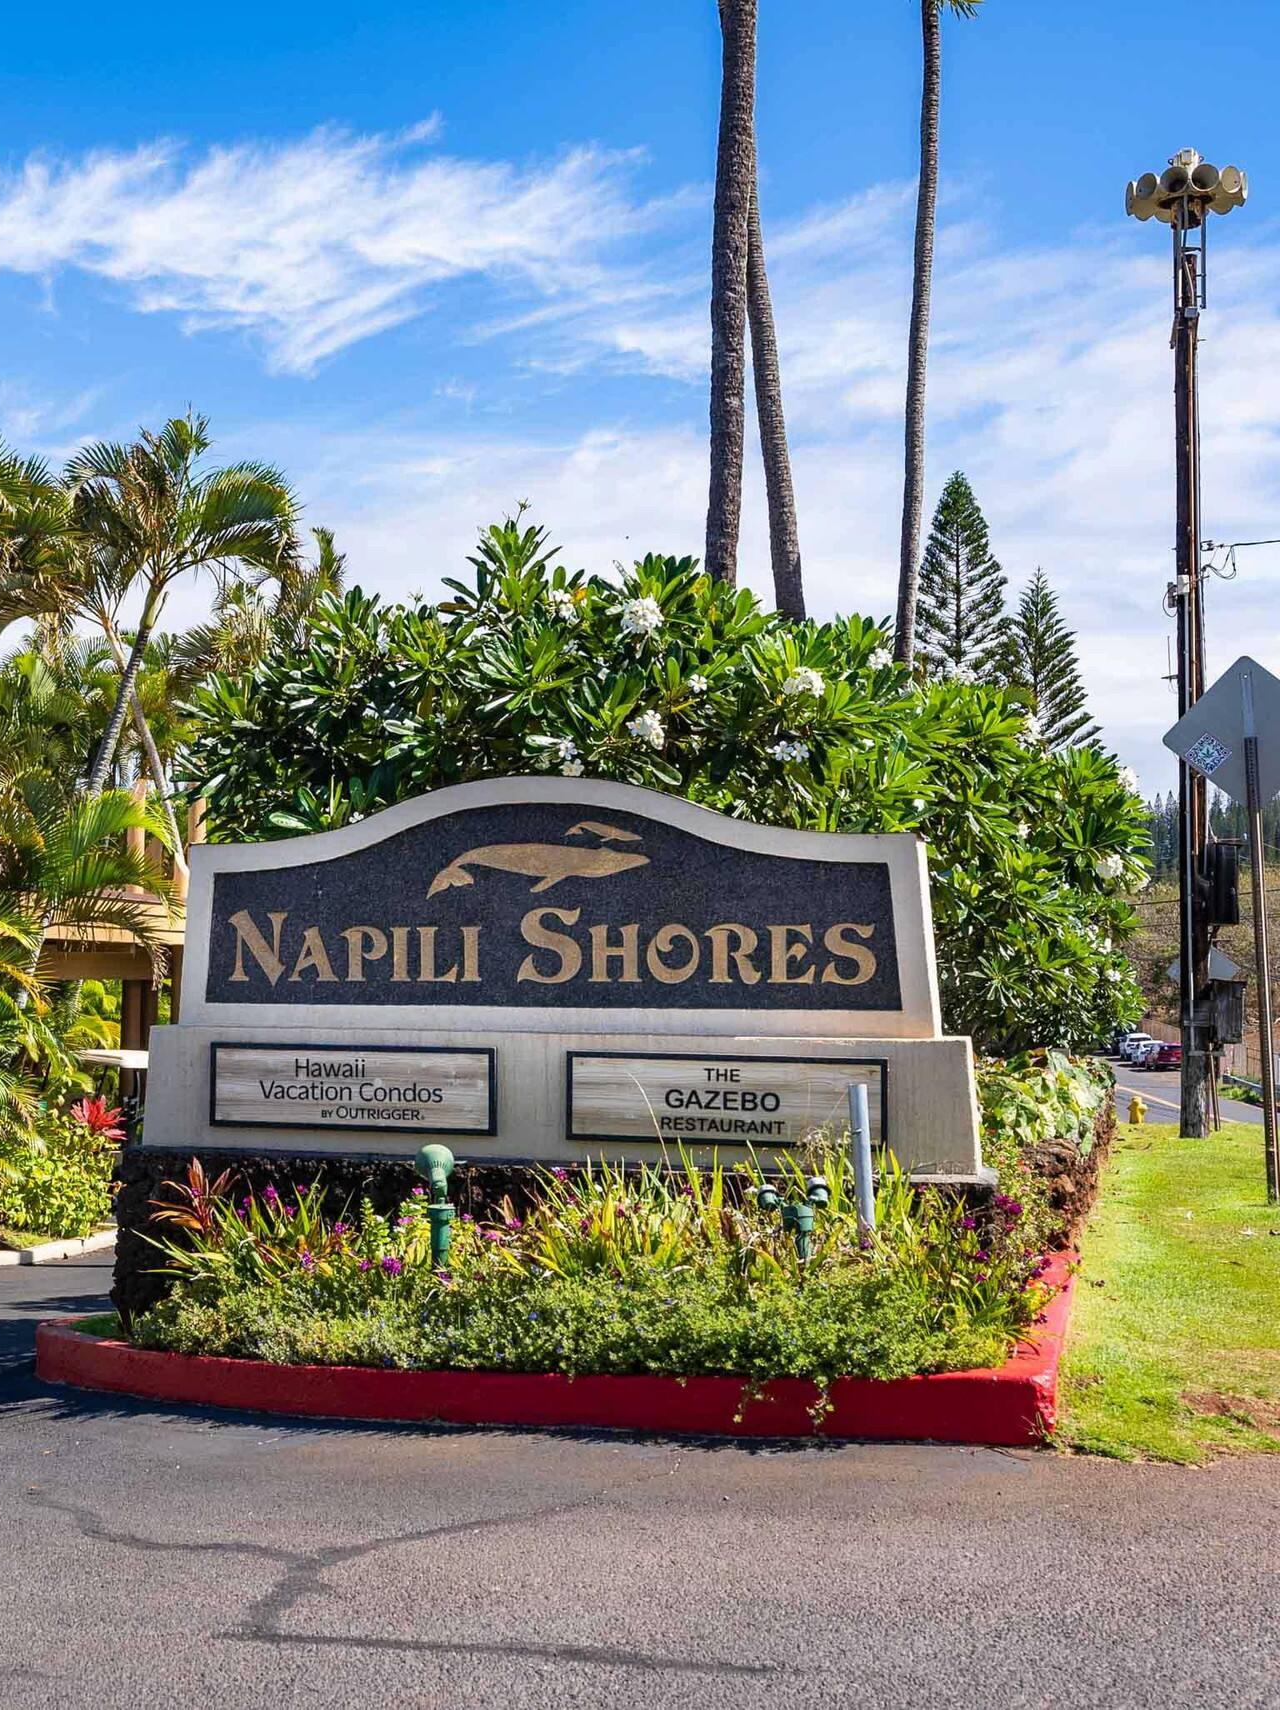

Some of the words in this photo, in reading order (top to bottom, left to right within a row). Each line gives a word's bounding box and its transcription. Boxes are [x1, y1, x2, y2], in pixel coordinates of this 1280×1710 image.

[228, 909, 482, 988] NAPILI
[516, 906, 877, 986] SHORES
[294, 1058, 366, 1078] Hawaii
[704, 1068, 741, 1083] THE
[259, 1080, 352, 1101] Vacation
[359, 1083, 444, 1103] Condos
[665, 1089, 781, 1112] GAZEBO
[321, 1109, 334, 1119] BY
[660, 1116, 786, 1135] RESTAURANT
